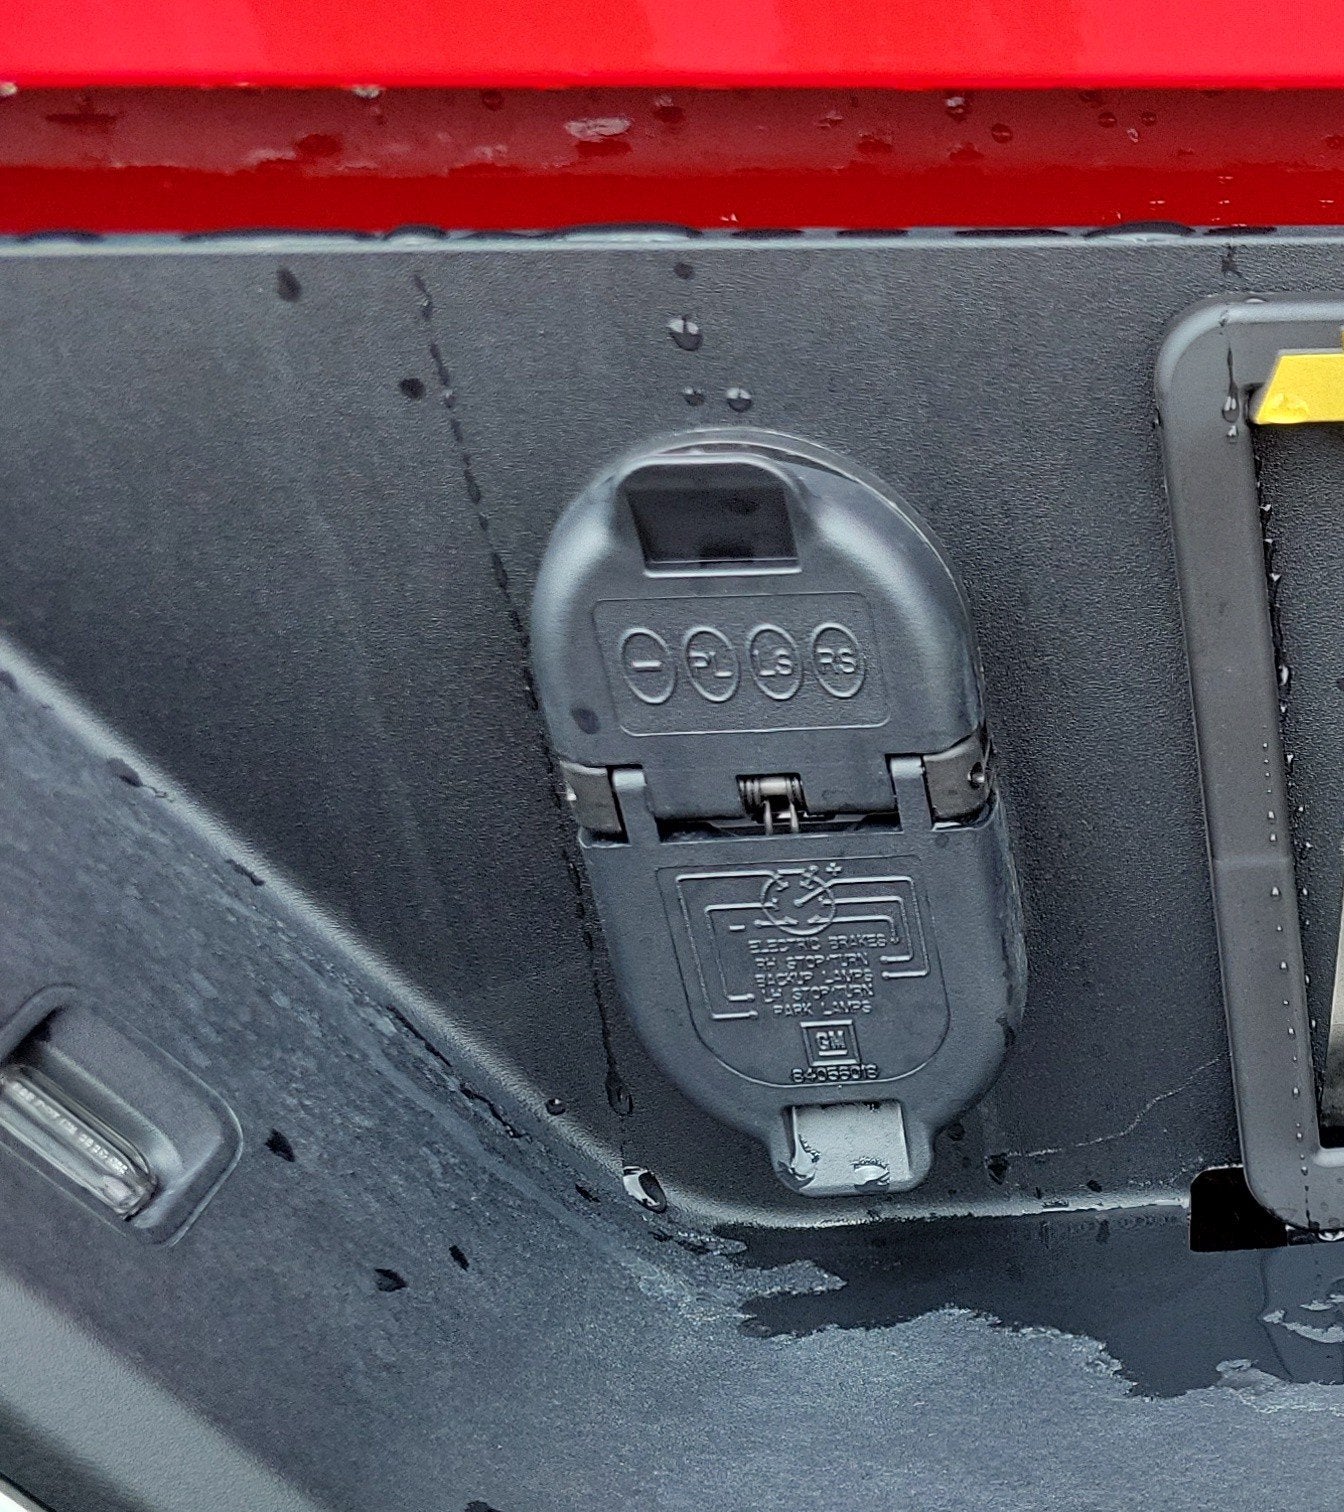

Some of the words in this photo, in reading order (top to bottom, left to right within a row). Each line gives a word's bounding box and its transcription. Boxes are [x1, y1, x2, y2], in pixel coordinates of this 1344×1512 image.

[688, 649, 734, 677] PL
[752, 649, 793, 677] LS
[815, 647, 857, 674] RS
[747, 935, 822, 954] ELECTRIC
[828, 933, 887, 950] BRAKES
[754, 956, 777, 970] RH
[754, 970, 814, 988] BACKUP
[821, 967, 874, 984] LAMPS
[772, 1002, 814, 1017] PARK
[821, 999, 873, 1016] LAMPS
